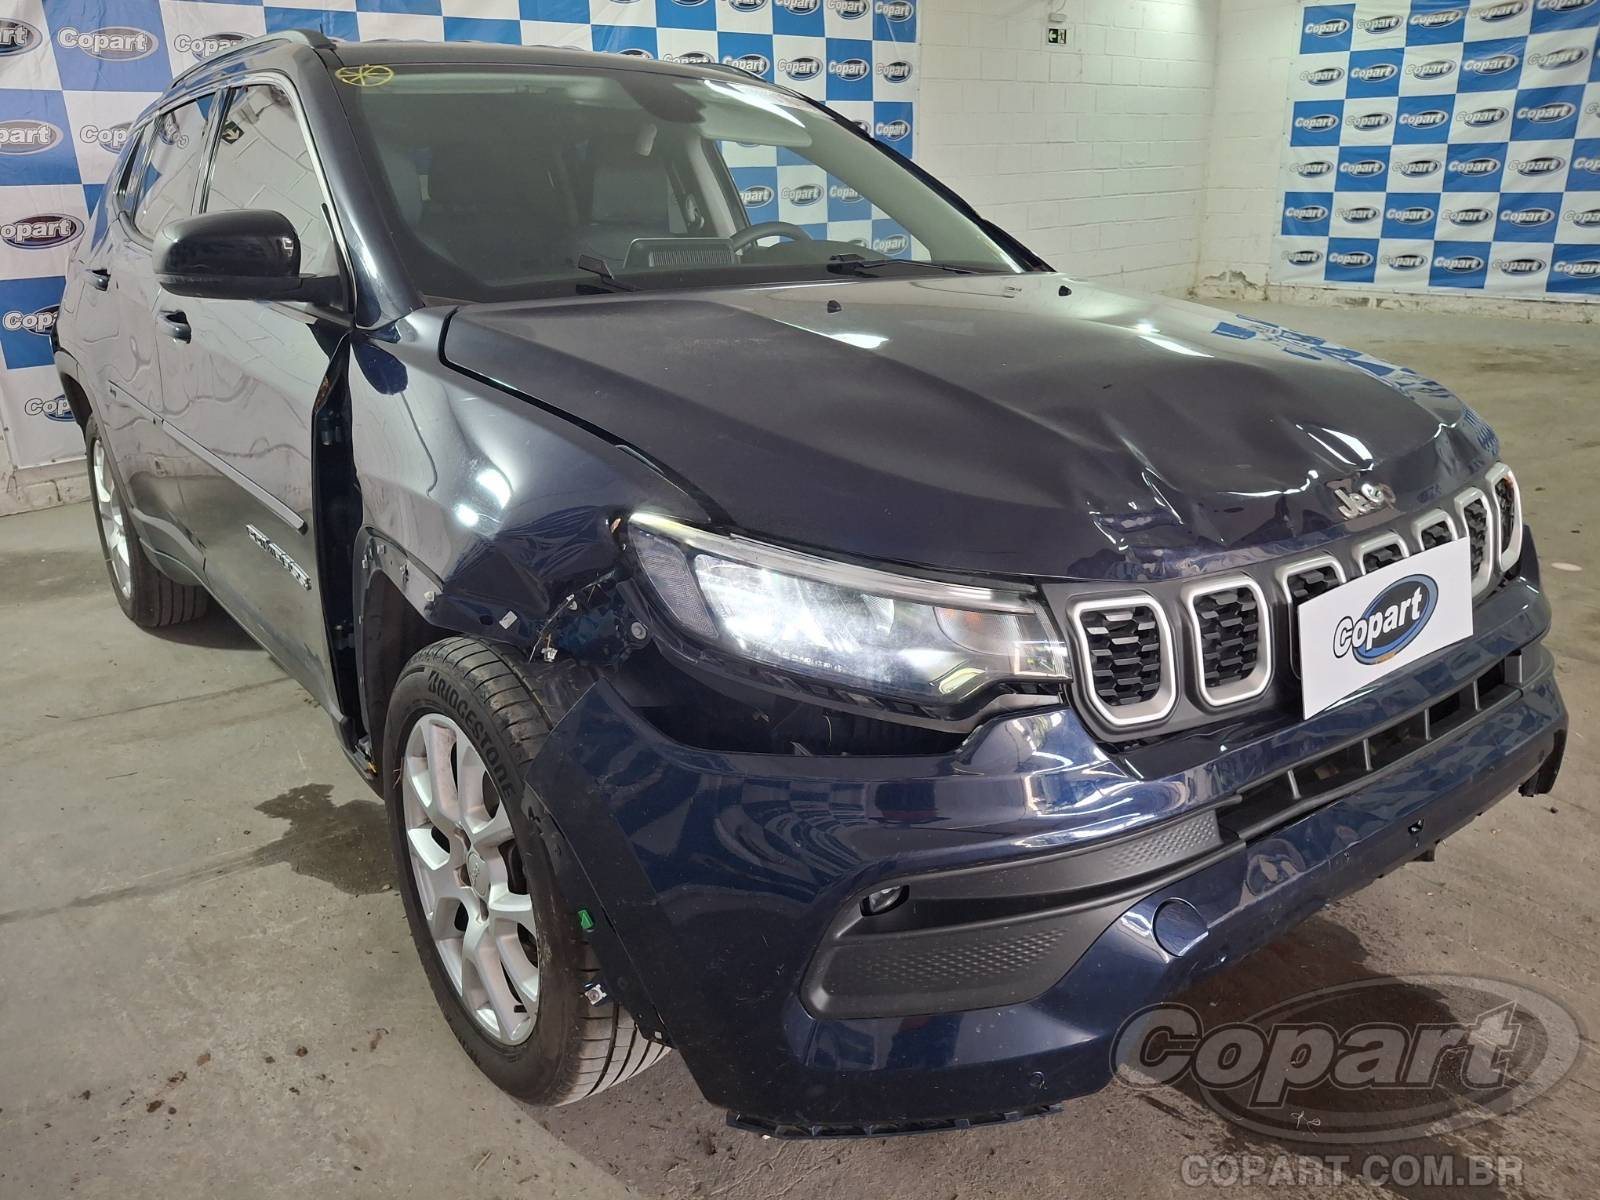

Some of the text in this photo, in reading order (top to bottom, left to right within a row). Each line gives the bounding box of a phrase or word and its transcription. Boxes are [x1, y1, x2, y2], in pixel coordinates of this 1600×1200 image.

[874, 2, 909, 15] Copart
[1471, 2, 1521, 19] Copart
[1357, 15, 1396, 32] Copart
[1410, 11, 1457, 26] Copart
[1305, 20, 1345, 36] Copart
[57, 26, 148, 52] Copart
[1464, 56, 1513, 73] Copart
[1528, 49, 1580, 67] Copart
[778, 59, 818, 75] Copart
[828, 62, 865, 76] Copart
[876, 63, 909, 77] Copart
[1351, 65, 1391, 80] Copart
[1406, 61, 1449, 77] Copart
[1300, 68, 1338, 83] Copart
[1400, 112, 1442, 127] Copart
[1456, 109, 1502, 124] Copart
[1517, 104, 1570, 120] Copart
[1295, 116, 1335, 129] Copart
[1345, 114, 1385, 128] Copart
[0, 124, 49, 148] part
[80, 125, 128, 147] Cop
[876, 122, 906, 137] Copart
[1290, 162, 1329, 176] Copart
[1339, 161, 1380, 175] Copart
[1392, 161, 1434, 175] Copart
[1448, 159, 1494, 174] Copart
[1508, 158, 1557, 174] Copart
[1574, 157, 1600, 171] Cop
[782, 186, 819, 201] Copart
[1286, 206, 1323, 220] Copart
[1335, 208, 1374, 222] Copart
[1386, 208, 1429, 222] Copart
[1442, 209, 1488, 223] Copart
[1500, 209, 1549, 224] Copart
[1563, 210, 1600, 224] Copa
[0, 218, 72, 242] opart
[873, 235, 906, 252] Copart
[1281, 251, 1319, 264] Copart
[1328, 253, 1368, 266] Copart
[1381, 255, 1422, 269] Copart
[1434, 257, 1479, 271] Copart
[1492, 259, 1540, 273] Copart
[3, 311, 58, 331] Cop
[25, 398, 70, 416] Cop
[1333, 586, 1423, 658] Copart
[427, 670, 514, 799] BRIDGESTONE
